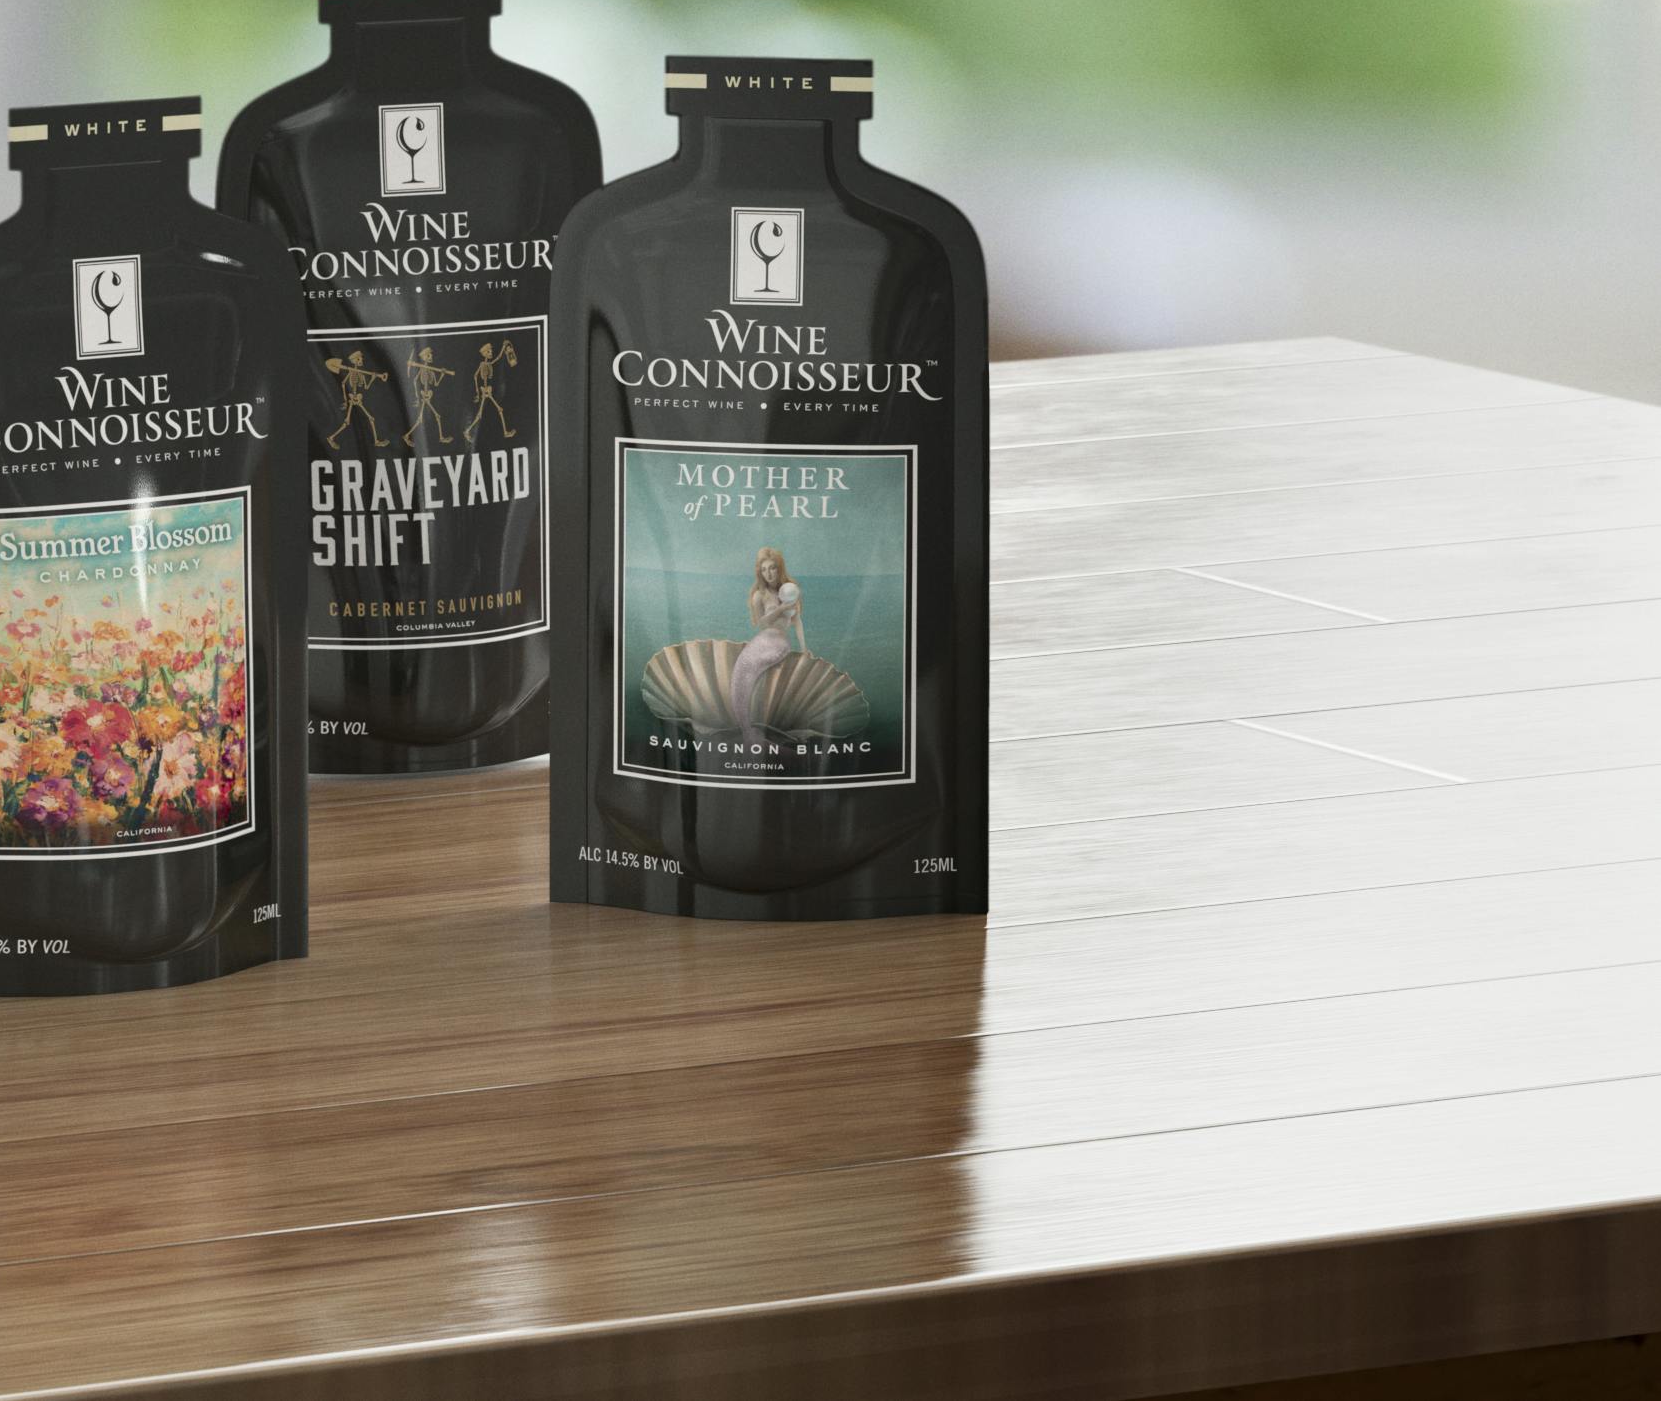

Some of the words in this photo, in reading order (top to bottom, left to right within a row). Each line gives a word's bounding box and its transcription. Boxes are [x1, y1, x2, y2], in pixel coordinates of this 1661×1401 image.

[725, 75, 814, 90] WHITE
[65, 119, 147, 137] WHITE
[360, 202, 471, 244] WINE
[368, 286, 401, 296] WINE
[436, 282, 479, 293] EVERY
[487, 279, 519, 290] TIME
[705, 309, 828, 356] WINE
[55, 366, 171, 411] WINE
[634, 398, 699, 408] PERFECT
[708, 400, 744, 410] WINE
[783, 402, 833, 412] EVERY
[843, 403, 879, 413] TIME
[65, 459, 100, 470] WINE
[136, 452, 180, 465] EVERY
[188, 447, 222, 459] TIME
[311, 446, 530, 512] GRAVEYARD
[677, 463, 850, 491] MOTHER
[684, 497, 707, 521] of
[713, 494, 840, 519] PEARL
[0, 532, 124, 561] Summer
[129, 520, 233, 553] Blossom
[312, 513, 435, 567] SHIFT
[39, 558, 202, 584] CHARDONNAY
[329, 601, 427, 617] CABERNET
[437, 589, 523, 615] SAUVIGNON
[396, 622, 443, 632] COLUMBIA
[446, 620, 476, 629] VALLEY
[320, 721, 339, 735] BY
[343, 721, 369, 735] VOL
[649, 735, 780, 755] SAUVIGNON
[797, 742, 873, 756] BLANC
[724, 762, 785, 771] CALIFORNIA
[116, 825, 173, 838] CALIFORNIA
[579, 846, 601, 863] ALC
[605, 849, 640, 869] 14.5%
[644, 855, 658, 871] BY
[662, 857, 685, 875] VOL
[913, 857, 958, 874] 125ML
[253, 903, 282, 924] 125ML
[17, 939, 38, 954] BY
[42, 939, 71, 954] VOL
